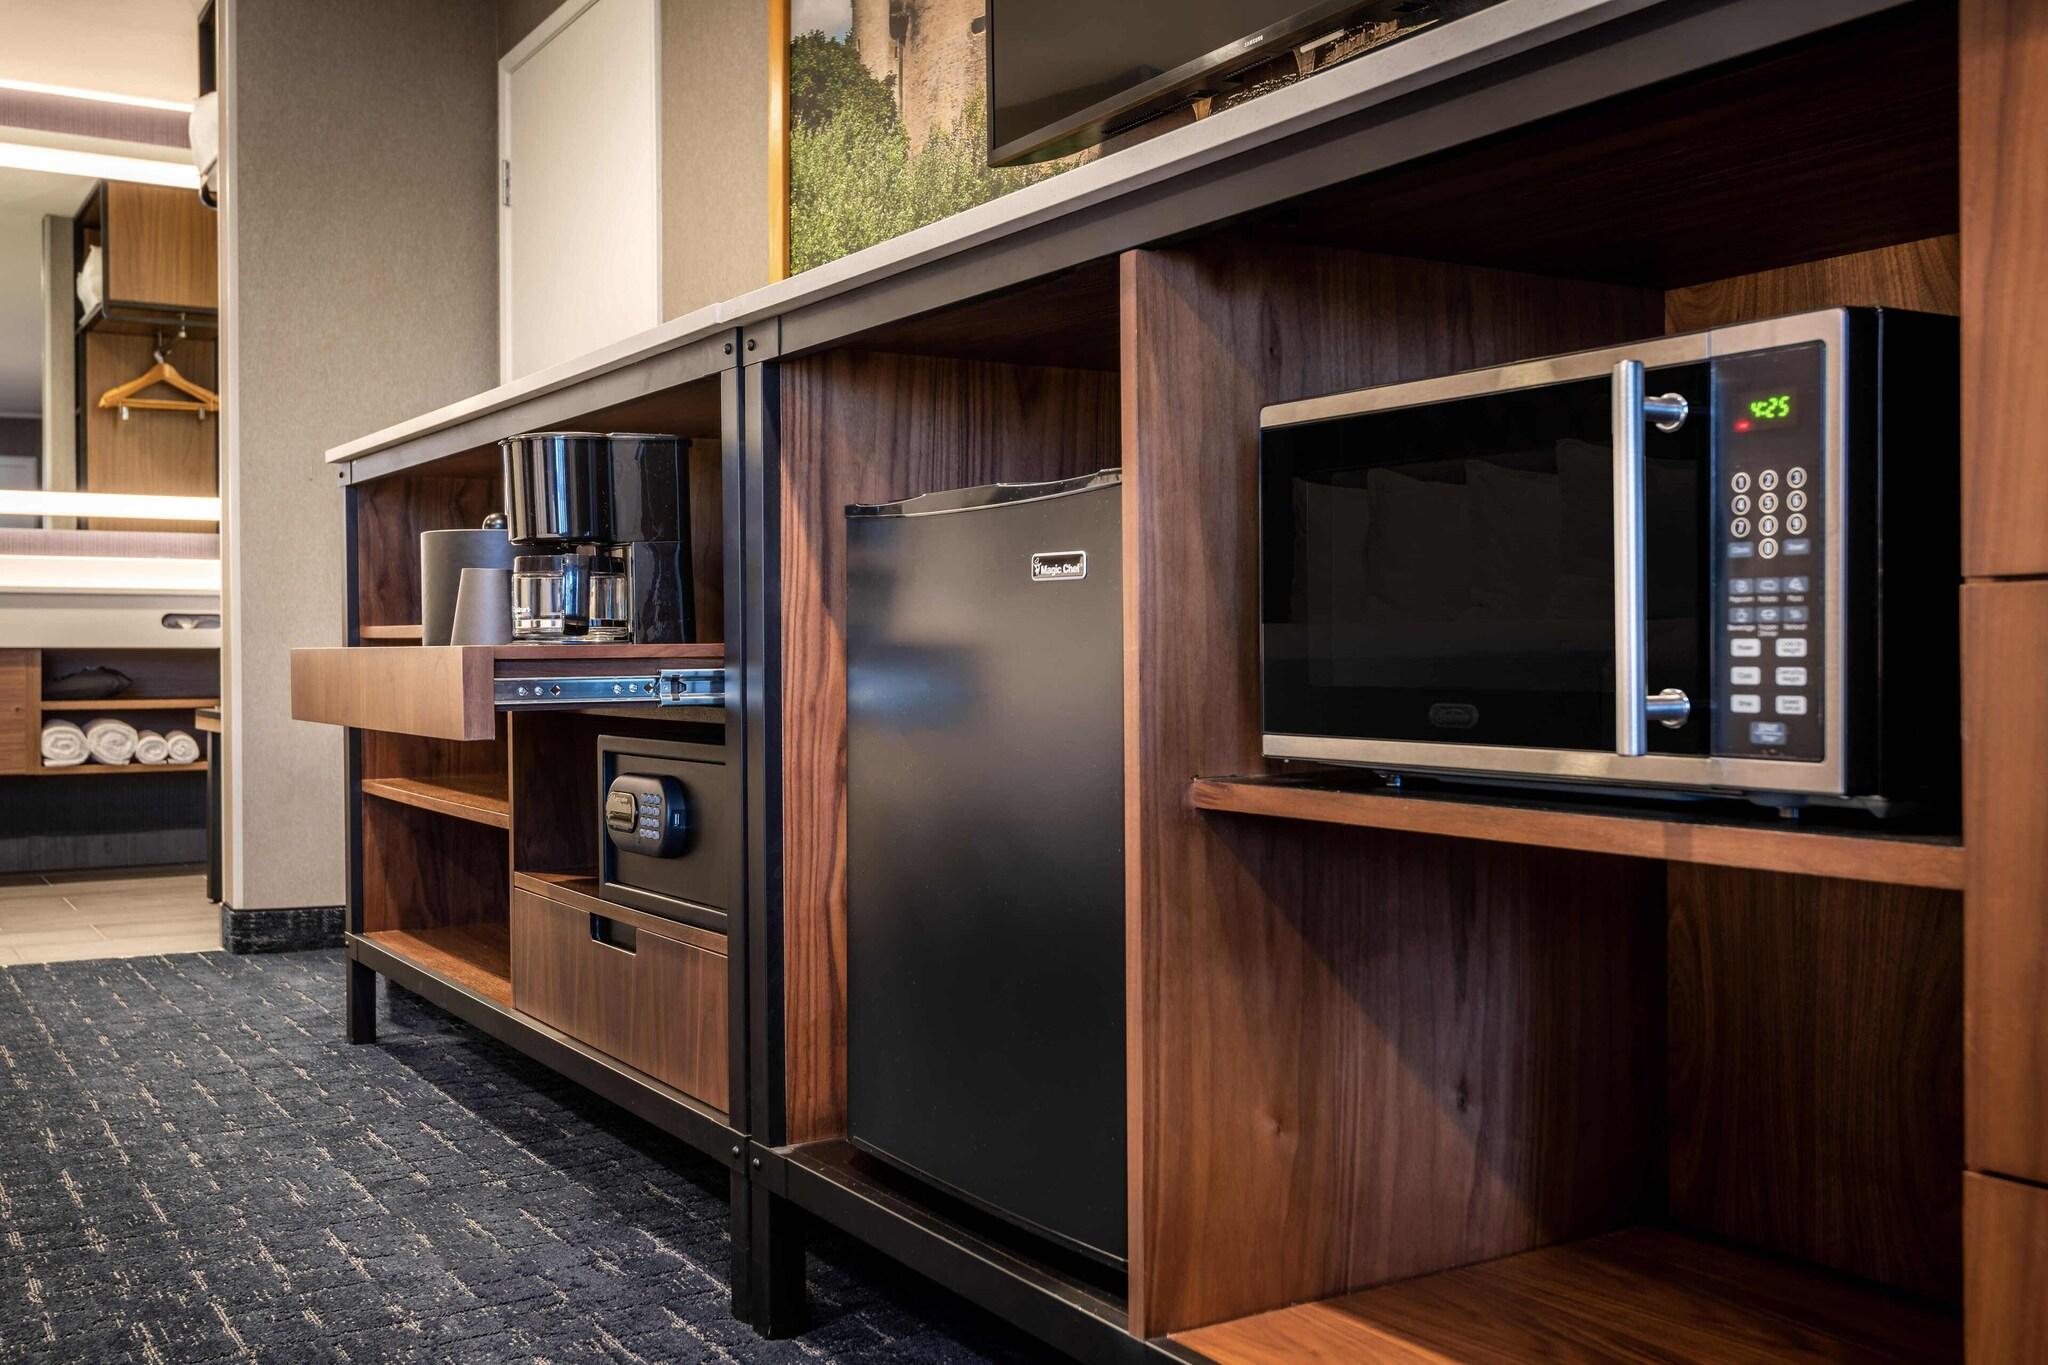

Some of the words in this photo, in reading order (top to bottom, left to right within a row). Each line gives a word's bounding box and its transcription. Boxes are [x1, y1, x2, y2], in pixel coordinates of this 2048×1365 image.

[1750, 395, 1790, 418] 4:25
[1040, 564, 1062, 576] Magic
[1063, 563, 1080, 574] Chef
